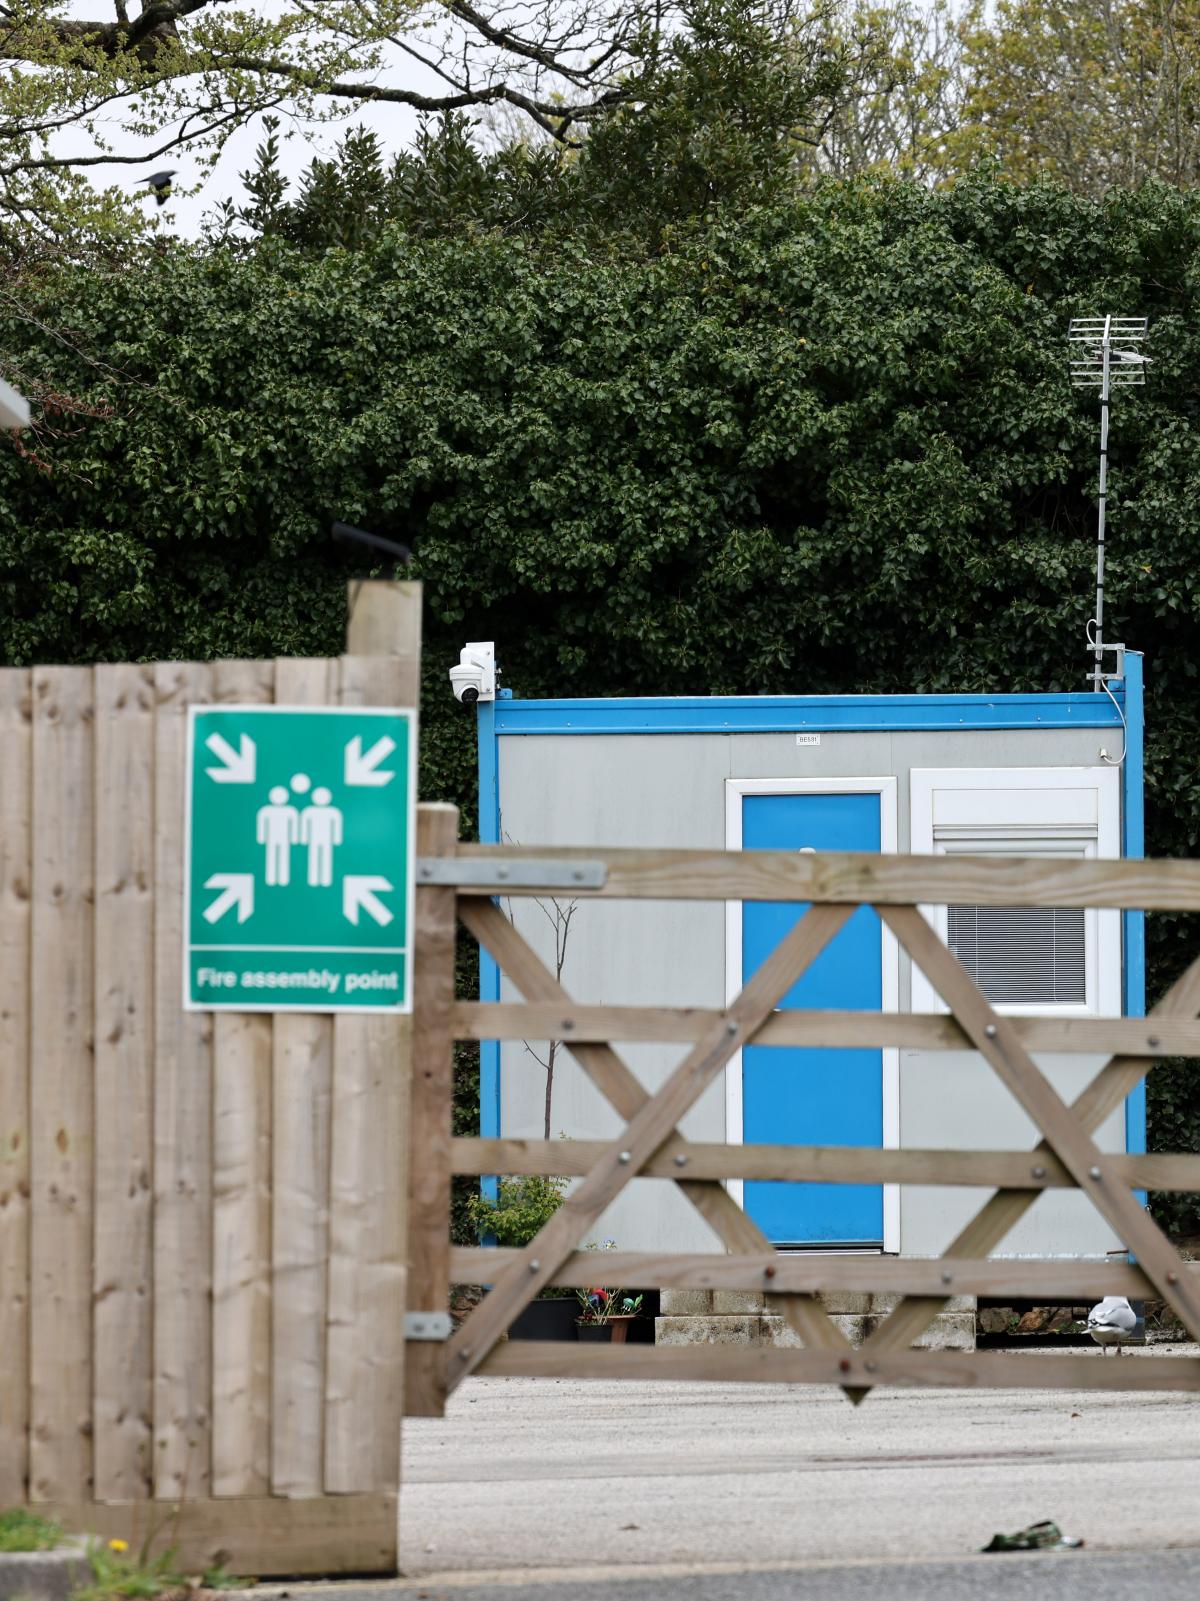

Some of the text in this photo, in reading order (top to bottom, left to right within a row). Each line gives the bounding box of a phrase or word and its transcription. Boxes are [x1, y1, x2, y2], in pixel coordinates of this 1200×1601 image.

[197, 967, 399, 993] Fire assembly point
